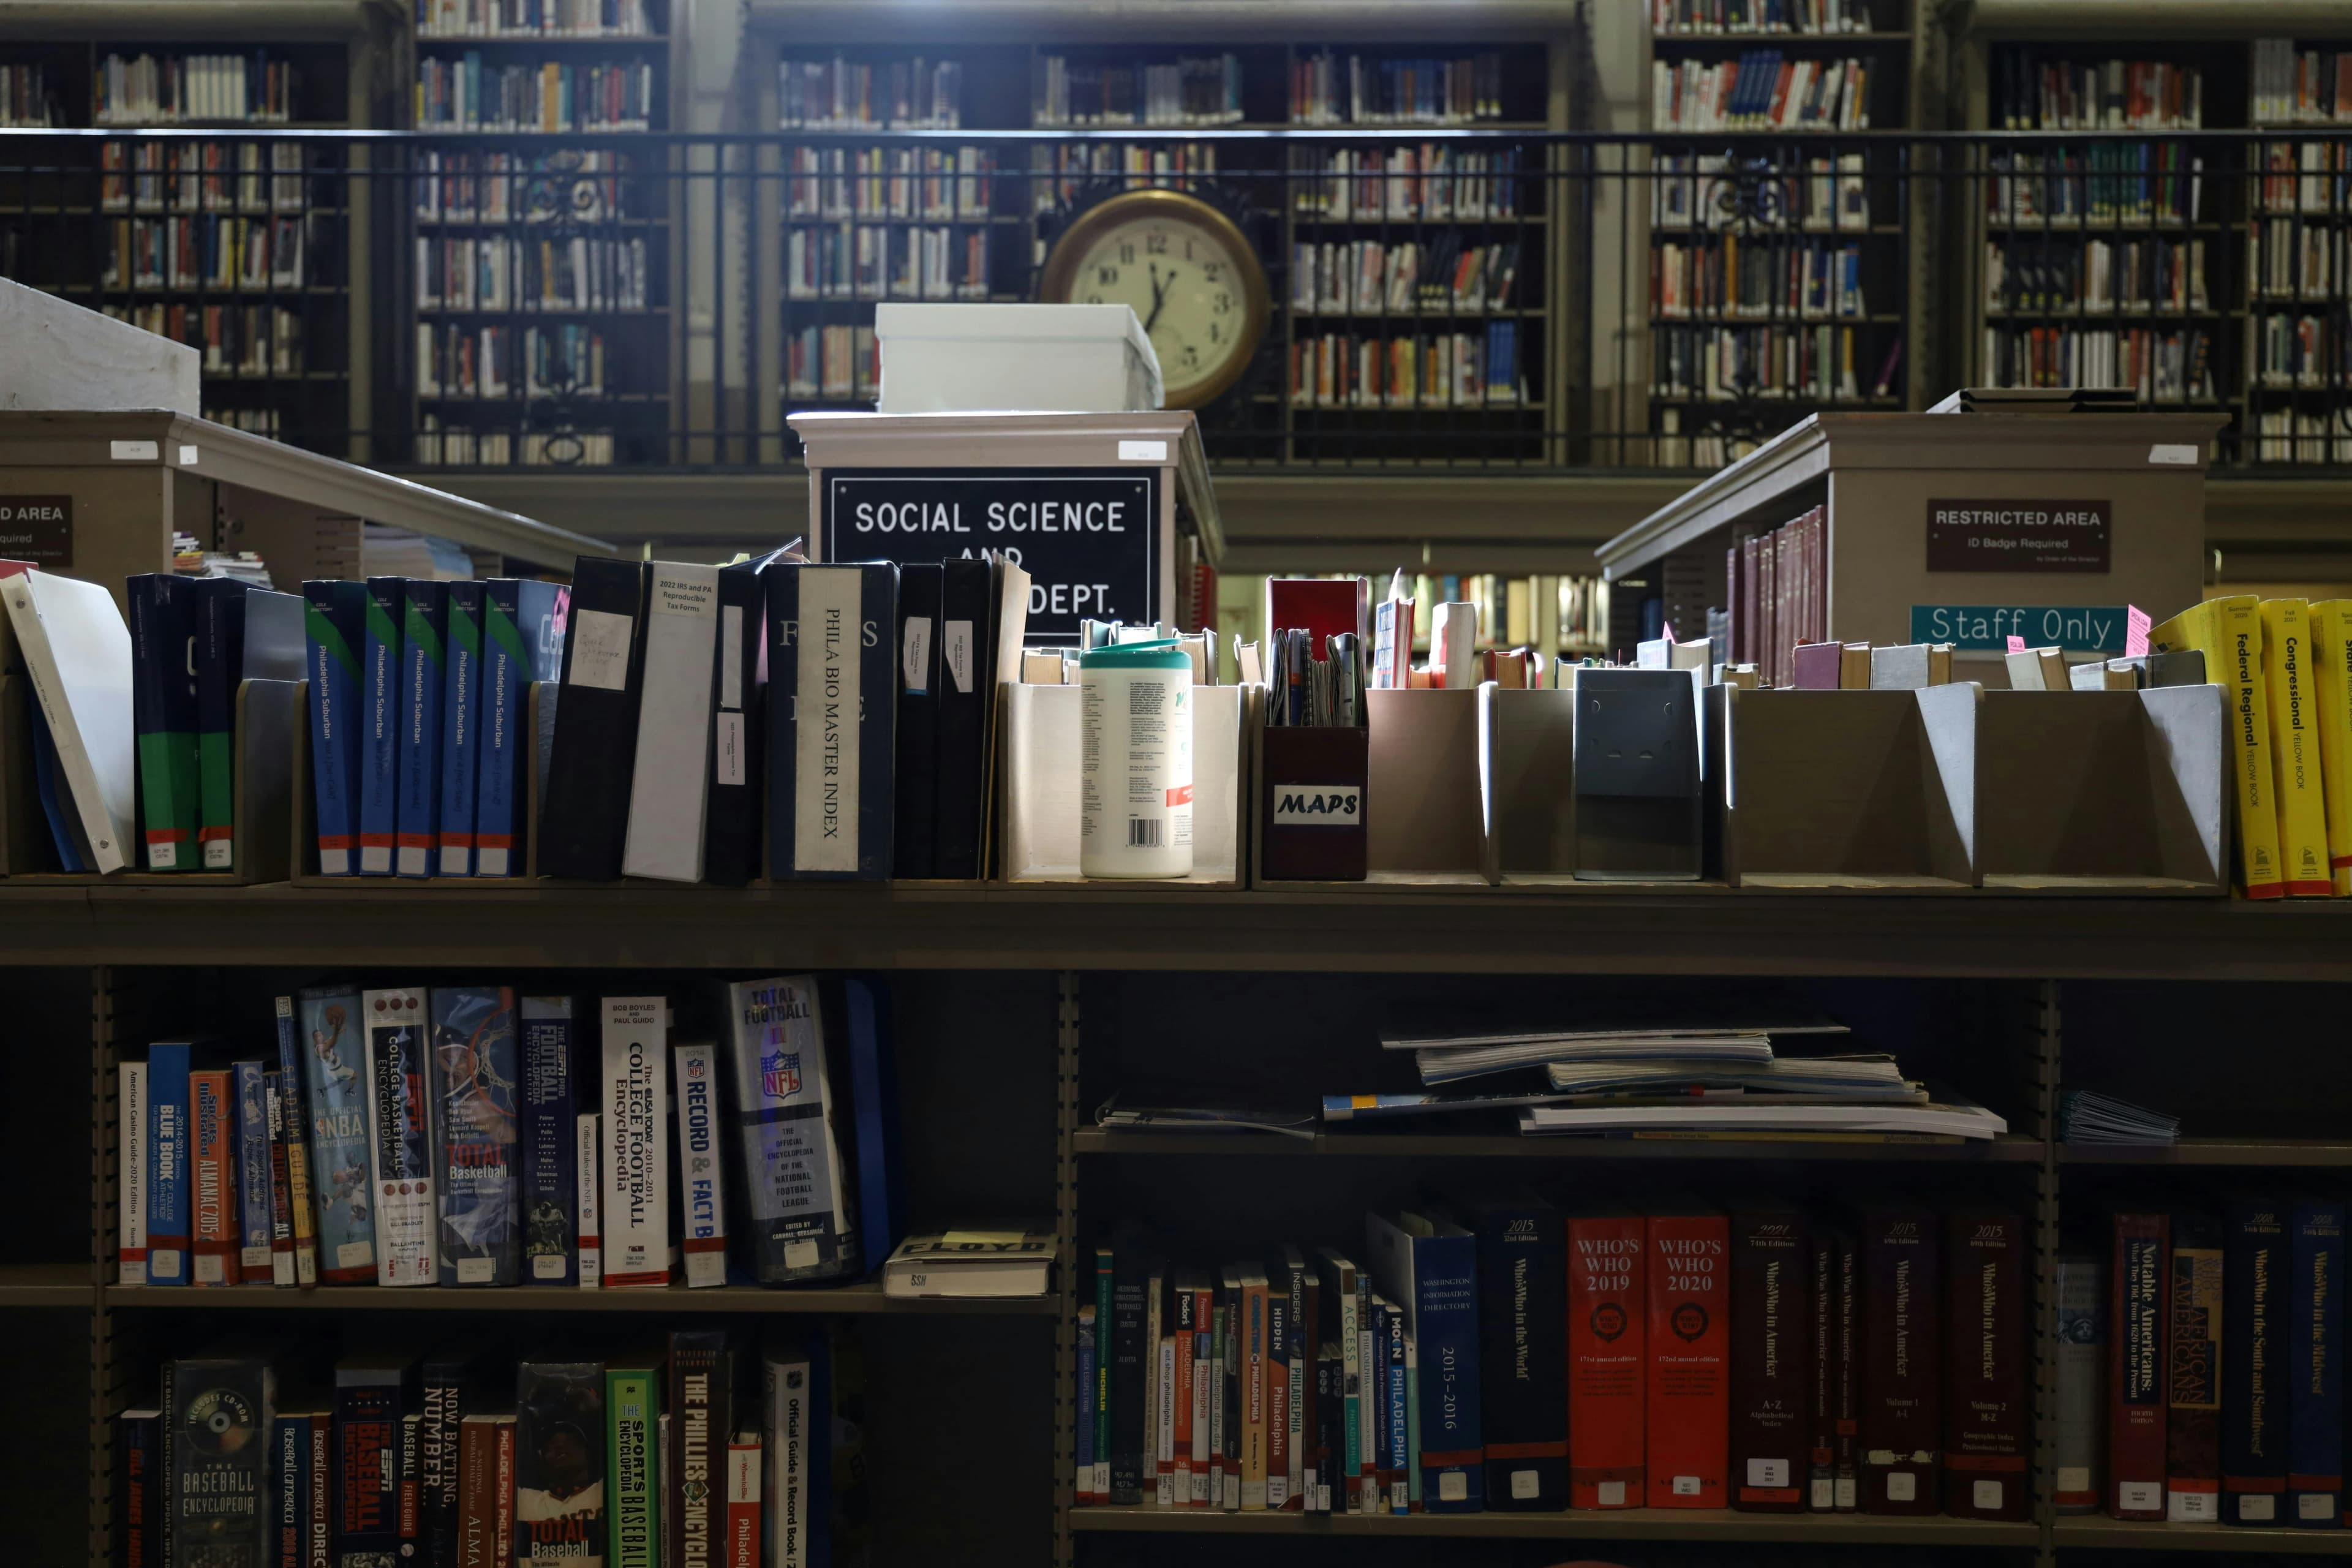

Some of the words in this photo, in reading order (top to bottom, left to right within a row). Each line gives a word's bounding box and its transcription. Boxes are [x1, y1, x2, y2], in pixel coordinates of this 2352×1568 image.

[17, 507, 64, 521] AREA
[855, 501, 971, 533] SOCIAL
[986, 501, 1126, 533] SCIENCE
[1936, 510, 2048, 526] RESTRICTED
[2052, 511, 2101, 526] AREA
[1967, 537, 1980, 548] ID
[1983, 537, 2017, 550] Badge
[2020, 538, 2069, 550] Required
[660, 580, 676, 589] 2022
[689, 584, 701, 592] and
[663, 591, 706, 603] Reproducible
[1028, 584, 1115, 614] DEPT.
[679, 604, 700, 612] Forms
[826, 608, 840, 662] PHILA
[1931, 608, 2026, 639] Staff
[2043, 609, 2112, 650] Only
[318, 645, 329, 697] Philadelphia
[375, 645, 385, 697] Philadelphia
[415, 649, 424, 702] Philadelphia
[2236, 633, 2252, 684] Federal
[458, 650, 468, 703] Philadelphia
[496, 654, 506, 706] Philadelphia
[825, 667, 840, 698] BIO
[2285, 636, 2305, 730] Congressional
[375, 698, 385, 739] Suburban
[413, 703, 423, 744] Suburban
[456, 704, 466, 745] Suburban
[494, 707, 504, 748] Suburban
[2239, 687, 2258, 747] Regional
[824, 703, 840, 777] MASTER
[2293, 732, 2304, 763] YELLOW
[2248, 748, 2258, 780] YELLOW
[2295, 765, 2304, 789] BOOK
[824, 782, 839, 839] INDEX
[1277, 793, 1358, 815] MAPS
[2249, 783, 2259, 807] BOOK
[751, 987, 796, 1005] TOTAL
[744, 1003, 810, 1025] FOOTBALL
[388, 1035, 401, 1091] COLLEGE
[540, 1024, 558, 1106] FOOTBALL
[630, 1042, 643, 1126] COLLEGE
[763, 1068, 801, 1095] NFL
[274, 1096, 283, 1133] Sports
[283, 1065, 300, 1138] STADIUM
[378, 1059, 391, 1150] ENCYCLOPEDIA
[687, 1081, 710, 1152] RECORD
[159, 1104, 175, 1139] BLUE
[199, 1082, 210, 1157] Illustrated
[325, 1117, 364, 1139] NBA
[391, 1095, 404, 1171] BASKETBALL
[614, 1078, 630, 1191] Encyclopedia
[445, 1142, 508, 1167] TOTAL
[582, 1126, 591, 1150] Official
[159, 1142, 175, 1181] BOOK
[290, 1150, 305, 1200] GUIDE
[449, 1164, 508, 1180] Basketball
[691, 1156, 711, 1174] &
[775, 1172, 812, 1184] NATIONAL
[198, 1159, 218, 1209] ALMANAC
[630, 1131, 644, 1229] FOOTBALL
[692, 1179, 714, 1222] FACT
[782, 1197, 810, 1208] LEAGUE
[200, 1211, 219, 1233] 2015
[1508, 1219, 1534, 1232] 2015
[1577, 1238, 1639, 1255] WHO'S
[1659, 1239, 1722, 1255] WHO'S
[2131, 1242, 2139, 1263] What
[1422, 1278, 1471, 1286] WASHINGTON
[1585, 1257, 1632, 1273] WHO
[1666, 1257, 1714, 1273] WHO
[2129, 1264, 2139, 1283] They
[2141, 1243, 2157, 1302] Notable
[1423, 1290, 1471, 1299] INFORMATION
[1586, 1275, 1630, 1292] 2019
[1667, 1275, 1713, 1292] 2020
[1181, 1294, 1190, 1325] Fodor's
[1424, 1303, 1471, 1312] DIRECTORY
[2131, 1302, 2139, 1321] from
[1273, 1307, 1282, 1350] HIDDEN
[1344, 1305, 1357, 1362] ACCESS
[2131, 1323, 2139, 1343] 1620
[2173, 1273, 2192, 1403] AMERICANS
[2131, 1354, 2139, 1368] the
[2140, 1305, 2156, 1392] Americans:
[2190, 1309, 2207, 1403] AFRICAN
[684, 1372, 709, 1405] THE
[1199, 1365, 1208, 1419] Philadelphia
[1213, 1365, 1221, 1409] Philadelphia
[1250, 1365, 1259, 1422] PHILADELPHIA
[1291, 1367, 1301, 1433] PHILADELPHIA
[2131, 1369, 2139, 1399] Present
[189, 1393, 221, 1425] INCLUDES
[445, 1387, 458, 1425] NOW
[622, 1404, 640, 1416] THE
[788, 1398, 799, 1436] Official
[1212, 1412, 1221, 1427] day
[1271, 1386, 1283, 1456] Philadelphia
[1392, 1368, 1405, 1468] PHILADELPHIA
[1970, 1401, 1999, 1411] Volume
[403, 1423, 415, 1477] BASEBALL
[619, 1420, 633, 1493] ENCYCLOPEDIA
[632, 1420, 646, 1493] SPORTS
[684, 1408, 709, 1480] PHILLIES
[788, 1439, 799, 1473] Guide
[183, 1471, 254, 1493] BASEBALL
[357, 1423, 381, 1531] BASEBALL
[380, 1449, 393, 1492] ESPN
[440, 1431, 458, 1509] BATTING,
[499, 1430, 509, 1505] PHILADELPHIA
[788, 1476, 798, 1485] &
[183, 1496, 254, 1517] ENCYCLOPEDIA
[404, 1485, 413, 1507] FIELD
[787, 1486, 798, 1526] Record
[404, 1509, 413, 1532] GUIDE
[497, 1508, 508, 1557] PHILLIES
[531, 1540, 589, 1558] Baseball
[786, 1527, 797, 1556] Book
